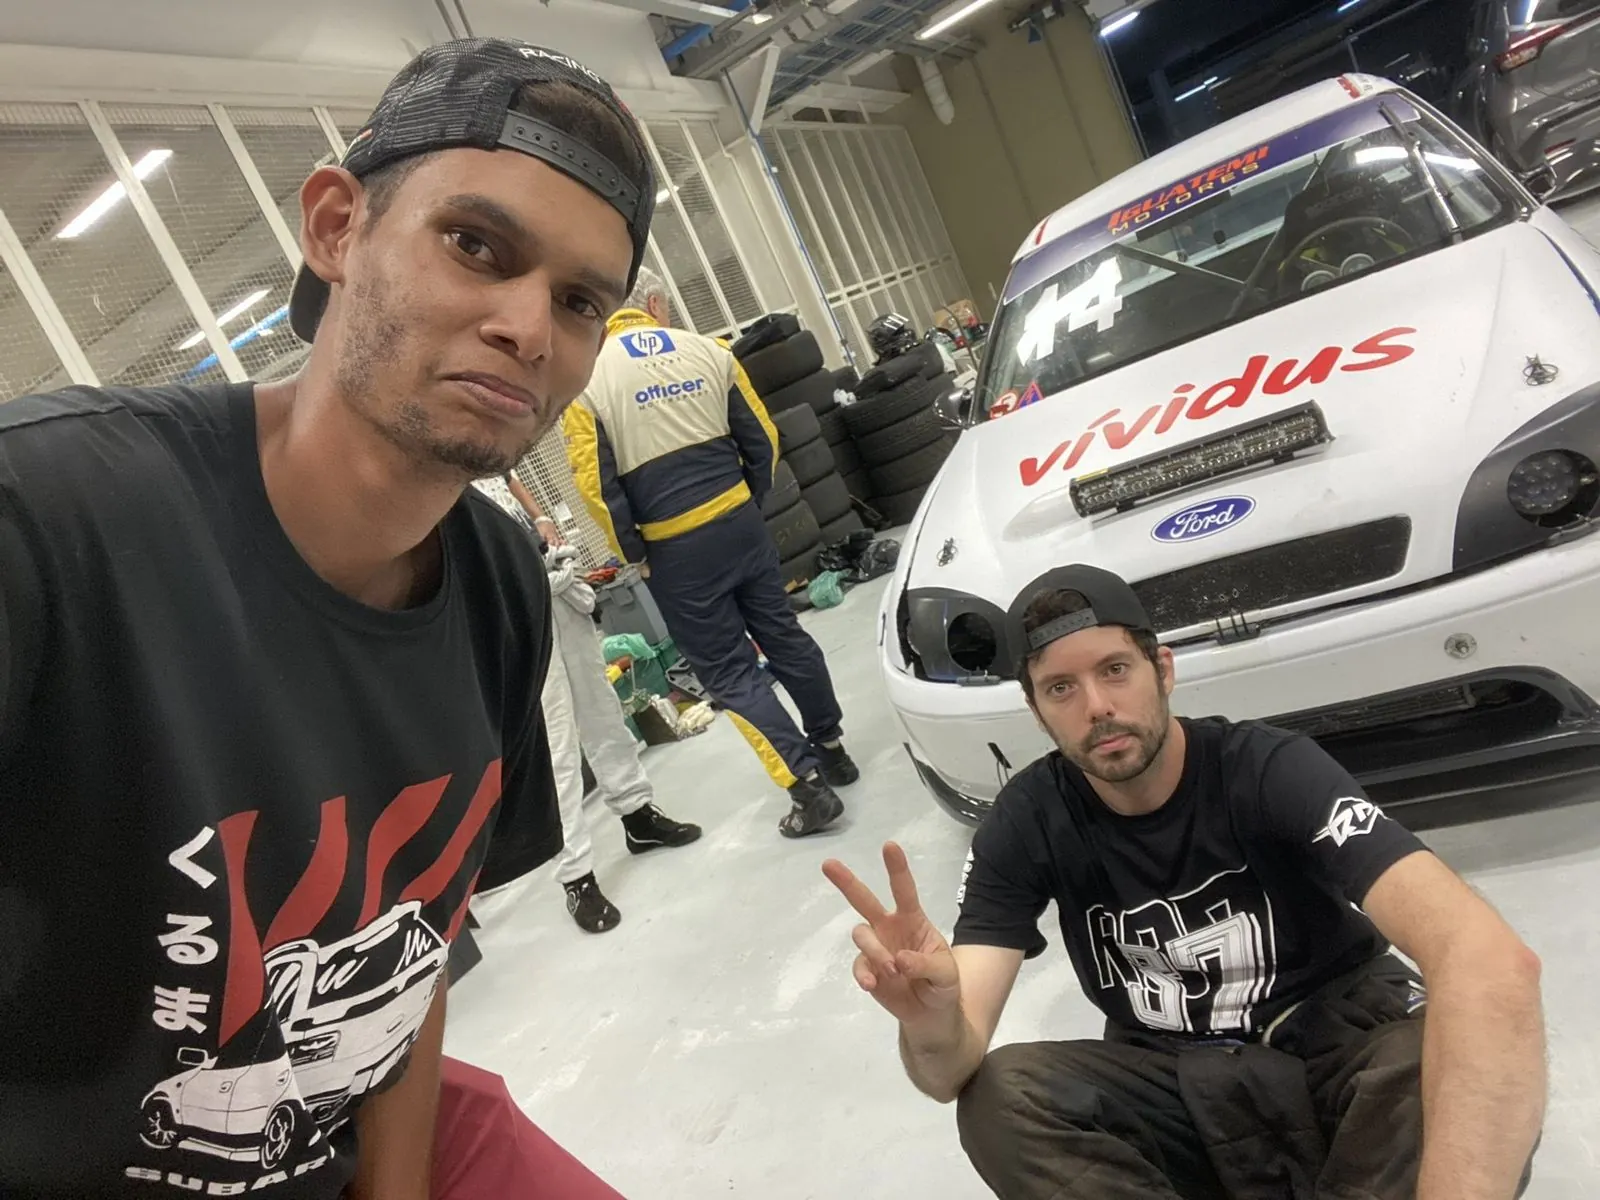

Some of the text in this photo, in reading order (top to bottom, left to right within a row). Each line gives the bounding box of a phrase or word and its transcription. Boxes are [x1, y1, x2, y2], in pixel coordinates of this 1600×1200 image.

[519, 48, 602, 83] RACING
[1108, 145, 1269, 229] IGUATEMI
[1112, 162, 1259, 236] MOTORES
[635, 378, 704, 403] officer
[1169, 501, 1236, 539] Ford
[152, 825, 218, 1034] くるま
[125, 1147, 336, 1196] SUBAR
